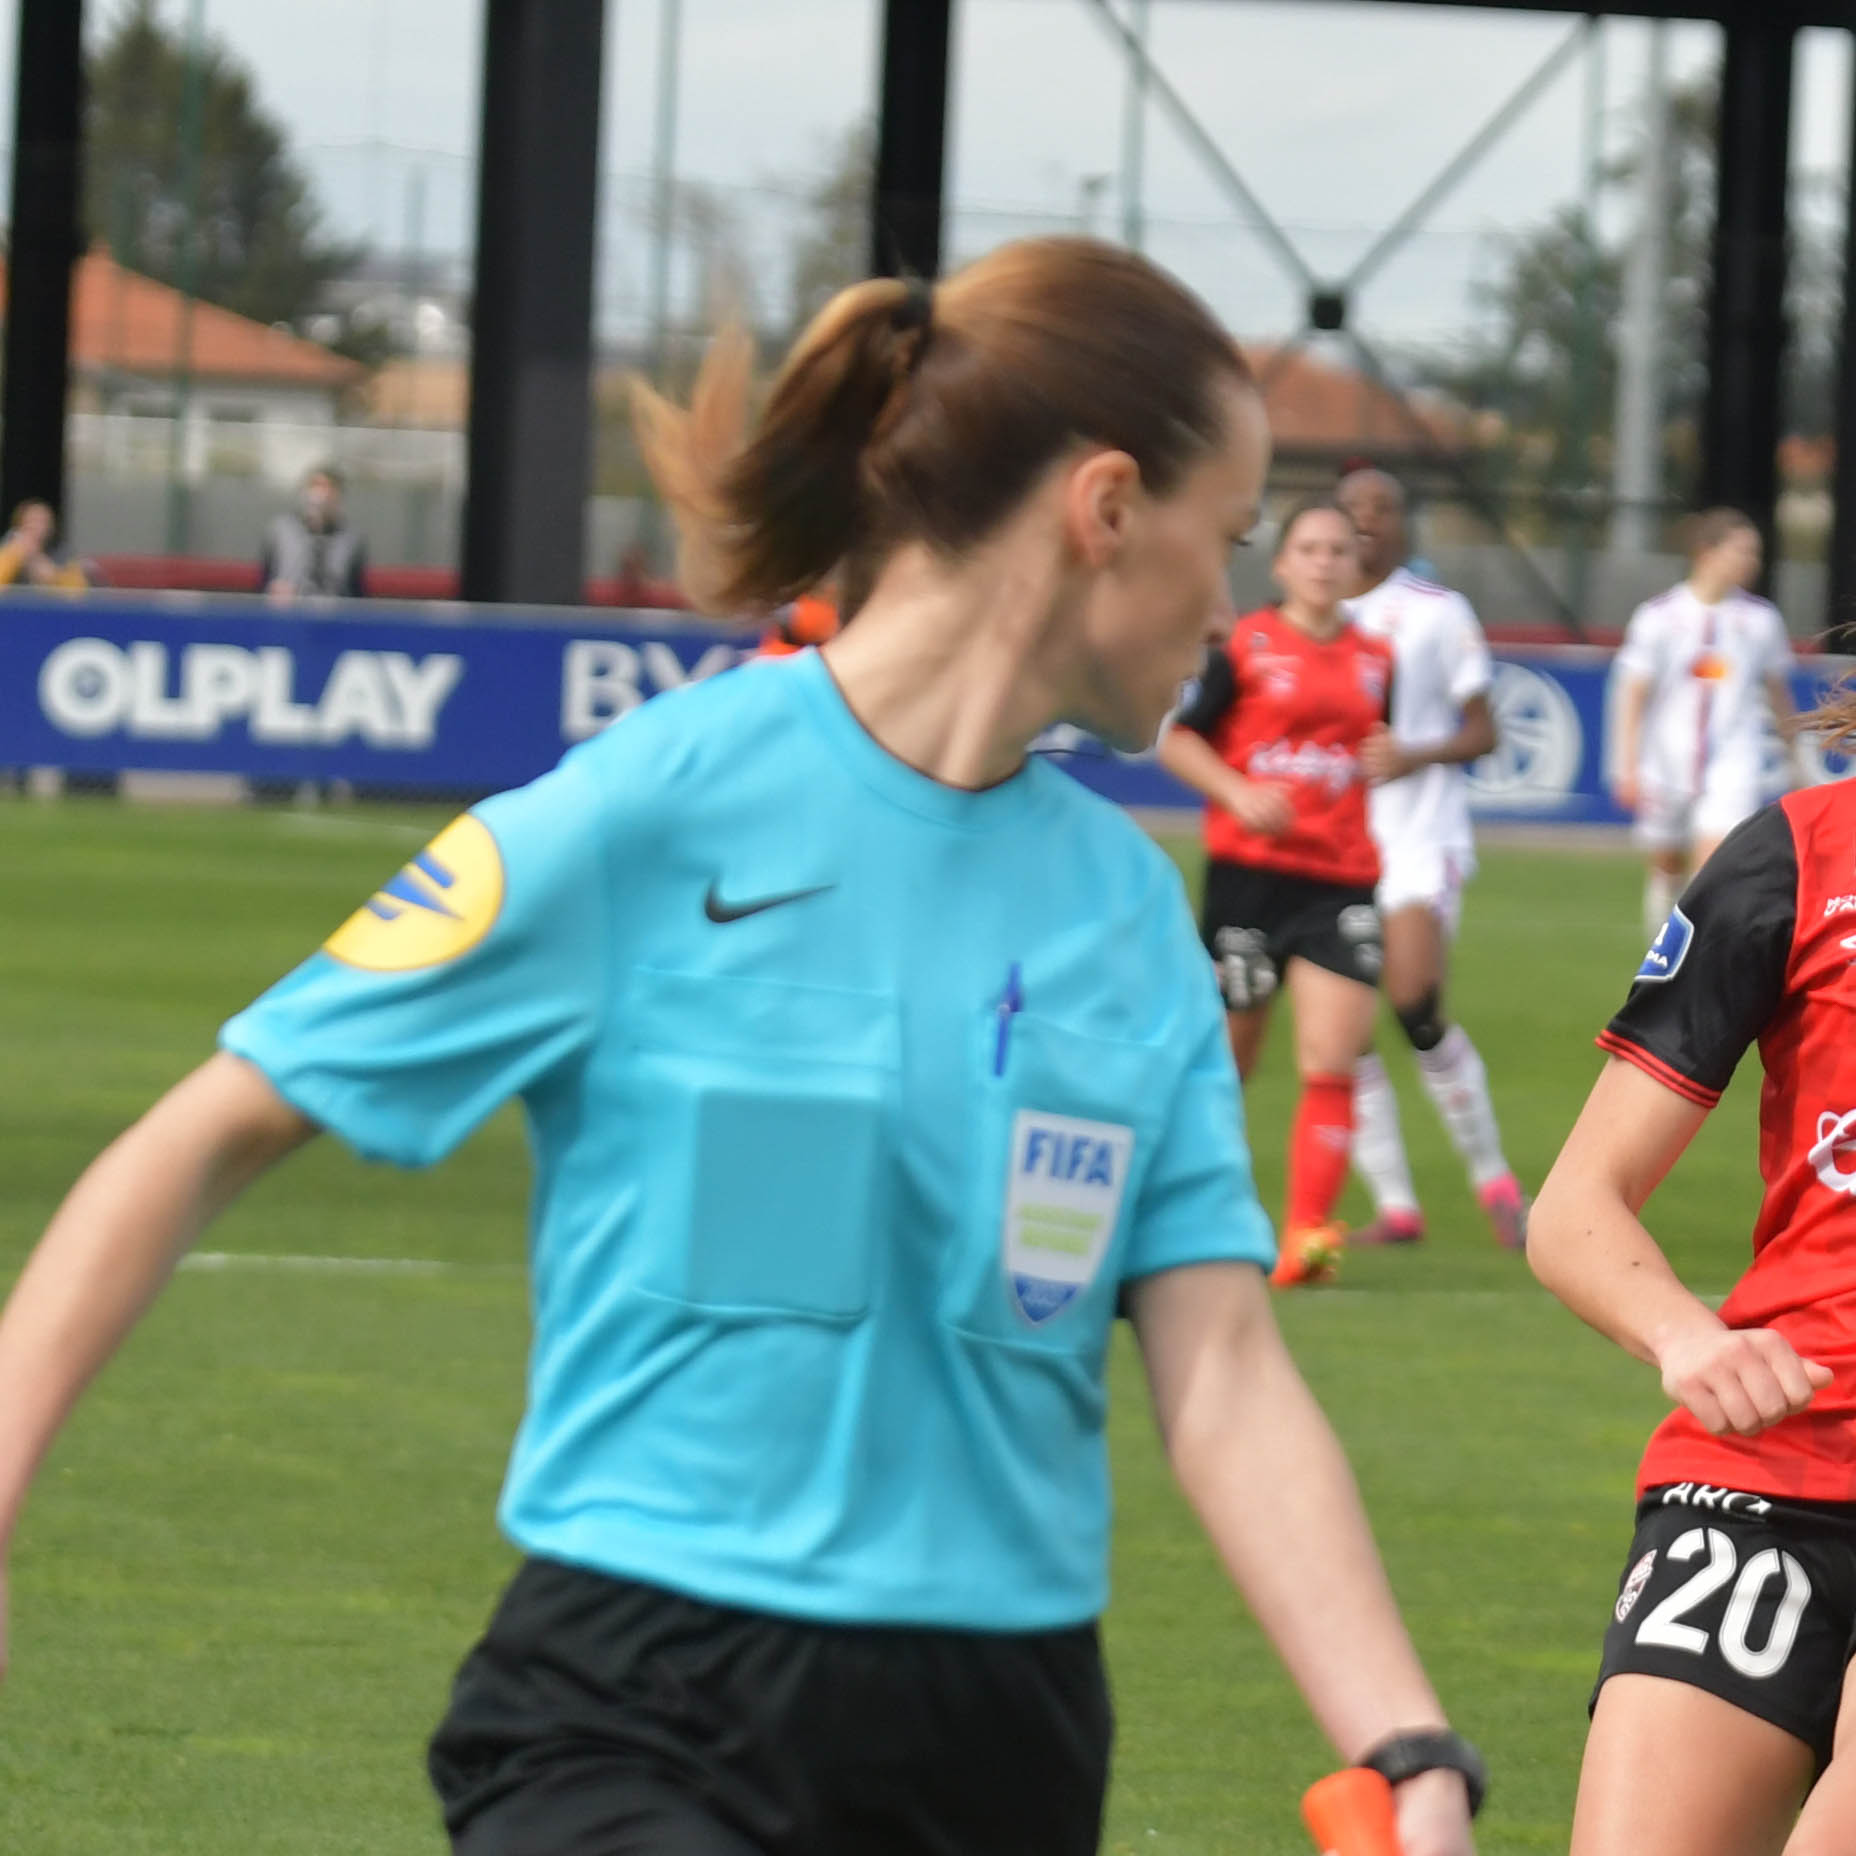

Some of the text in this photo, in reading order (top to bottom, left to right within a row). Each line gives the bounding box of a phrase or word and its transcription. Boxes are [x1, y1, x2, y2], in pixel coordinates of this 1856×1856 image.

[39, 637, 463, 750] OLPLAY
[1023, 1125, 1114, 1188] FIFA
[1635, 1526, 1812, 1680] 20
